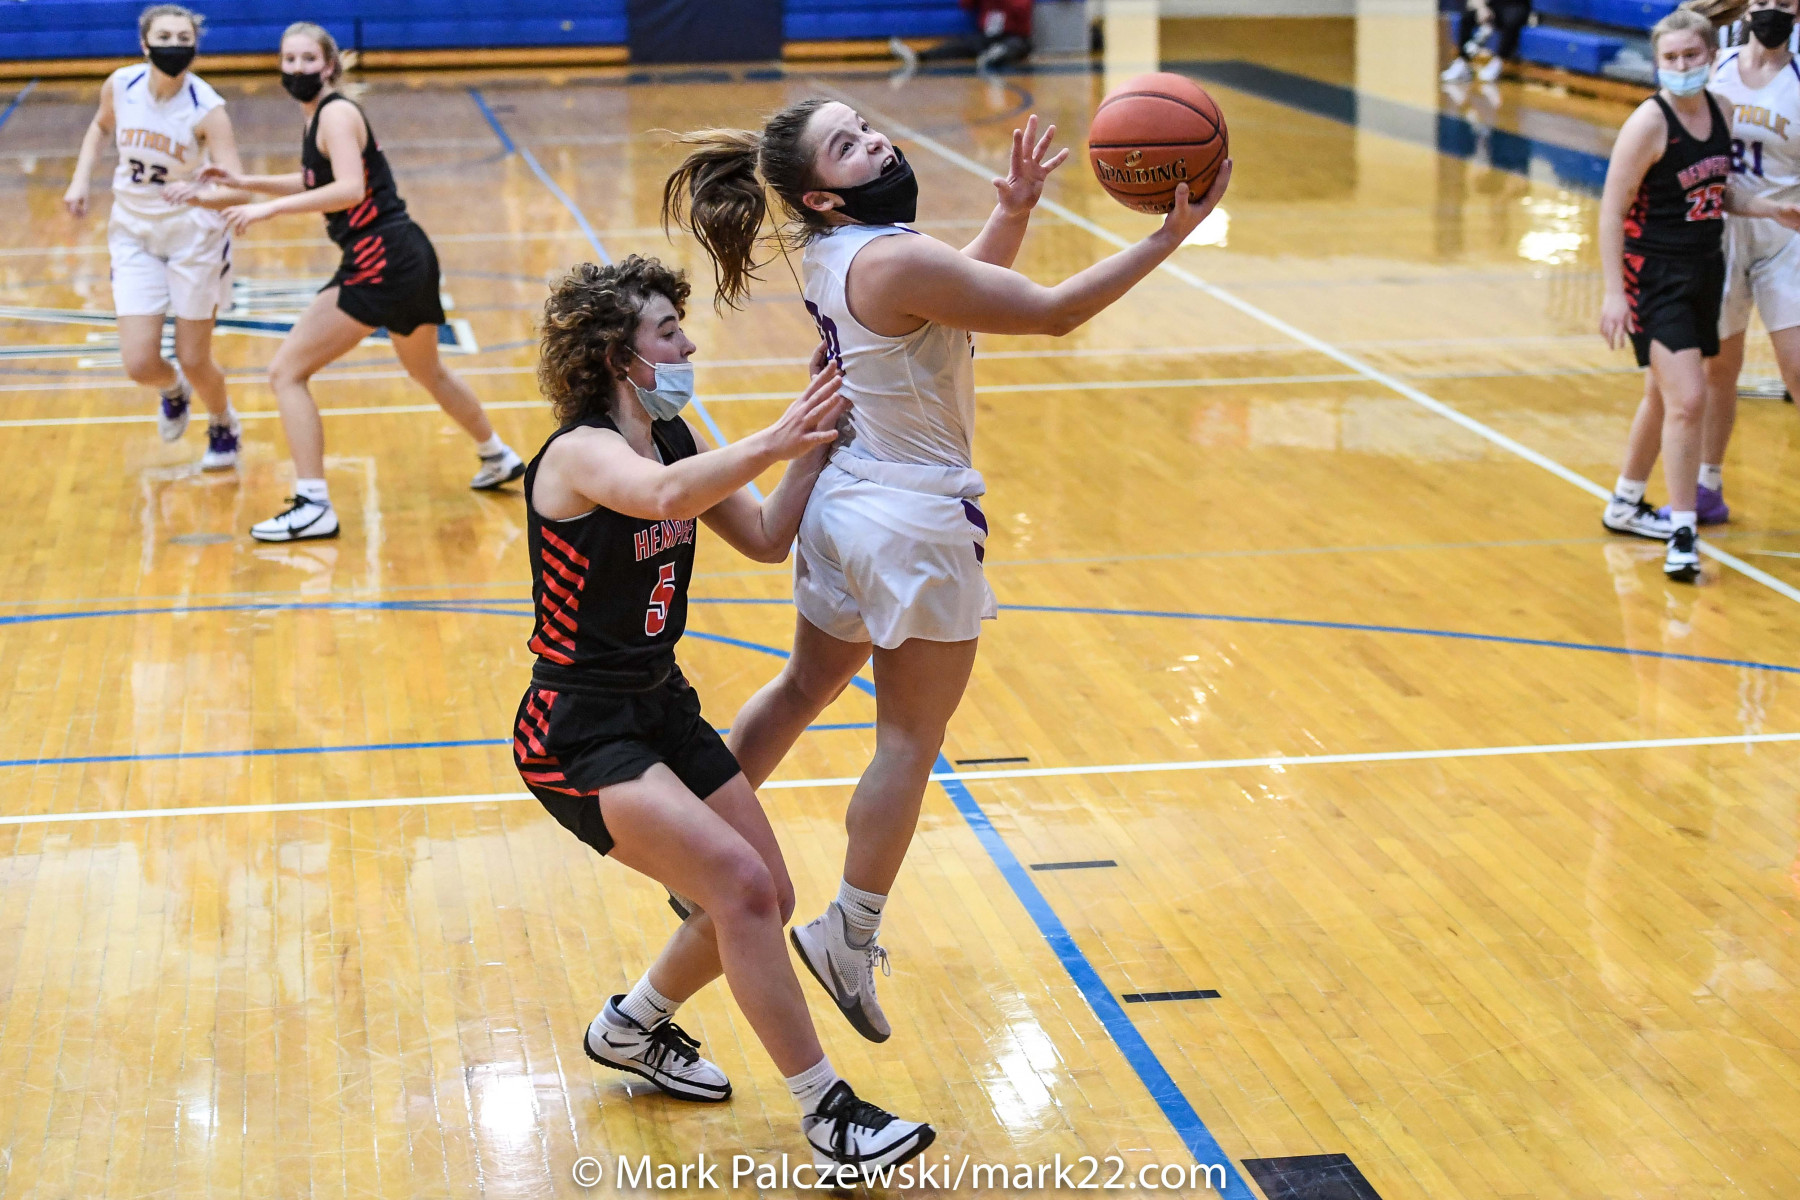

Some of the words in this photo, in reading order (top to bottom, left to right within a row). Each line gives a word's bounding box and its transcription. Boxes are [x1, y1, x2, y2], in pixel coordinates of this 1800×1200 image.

[120, 128, 187, 164] CATHOLIC
[1729, 138, 1764, 178] 21
[128, 157, 169, 186] 22
[1097, 158, 1188, 184] SPALDING
[644, 561, 676, 637] 5
